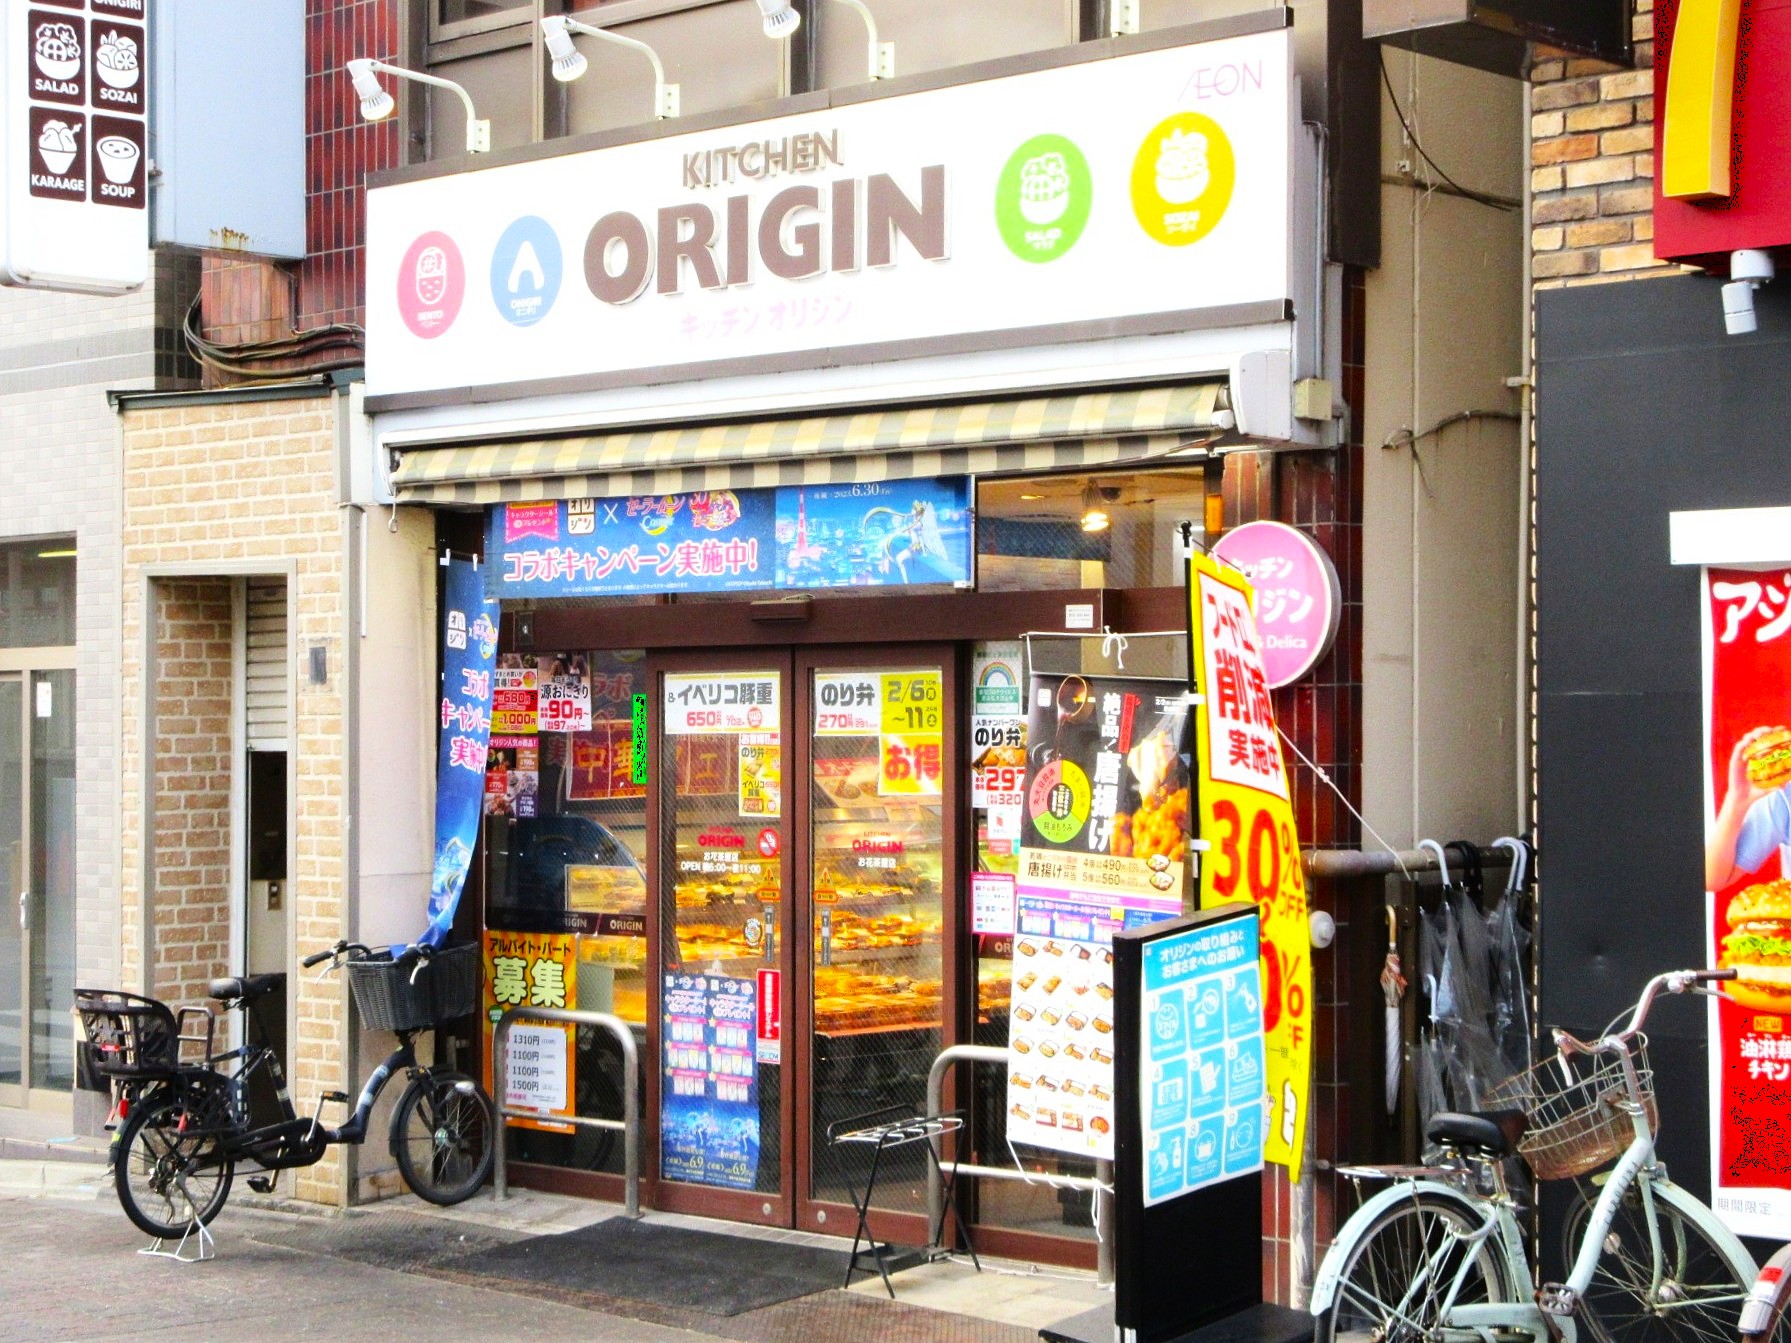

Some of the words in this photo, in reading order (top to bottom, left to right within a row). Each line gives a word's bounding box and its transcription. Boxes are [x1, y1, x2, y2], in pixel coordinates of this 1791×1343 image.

[35, 78, 79, 95] SALAD
[100, 88, 137, 104] SOZAI
[682, 128, 845, 190] KITCHEN
[31, 174, 85, 191] KARAAGE
[101, 184, 136, 198] SOUP
[583, 163, 952, 305] ORIGIN
[1025, 228, 1062, 243] SALAD
[510, 296, 542, 309] ONIGIRI
[417, 310, 444, 321] BENTO
[504, 536, 759, 582] コラボキャンペーン実施中!
[1253, 588, 1313, 625] ジン
[1267, 634, 1308, 649] Delica
[821, 682, 875, 706] のり弁
[888, 679, 924, 703] 2/6
[975, 727, 1021, 747] のり弁
[885, 743, 941, 781] お得
[697, 834, 746, 849] ORIGIN
[851, 839, 905, 854] ORIGIN
[681, 862, 701, 871] OPEN
[610, 919, 643, 931] ORIGIN
[1160, 930, 1244, 963] オリジンの取り組みと
[493, 956, 567, 1007] 募集
[1755, 1018, 1781, 1030] NEW
[513, 1034, 540, 1046] 1310円
[513, 1050, 540, 1061] 1100円
[512, 1065, 540, 1077] 1100円
[1747, 1060, 1791, 1081] チキン
[512, 1080, 540, 1091] 1500円
[1717, 1197, 1772, 1216] 期間限定
